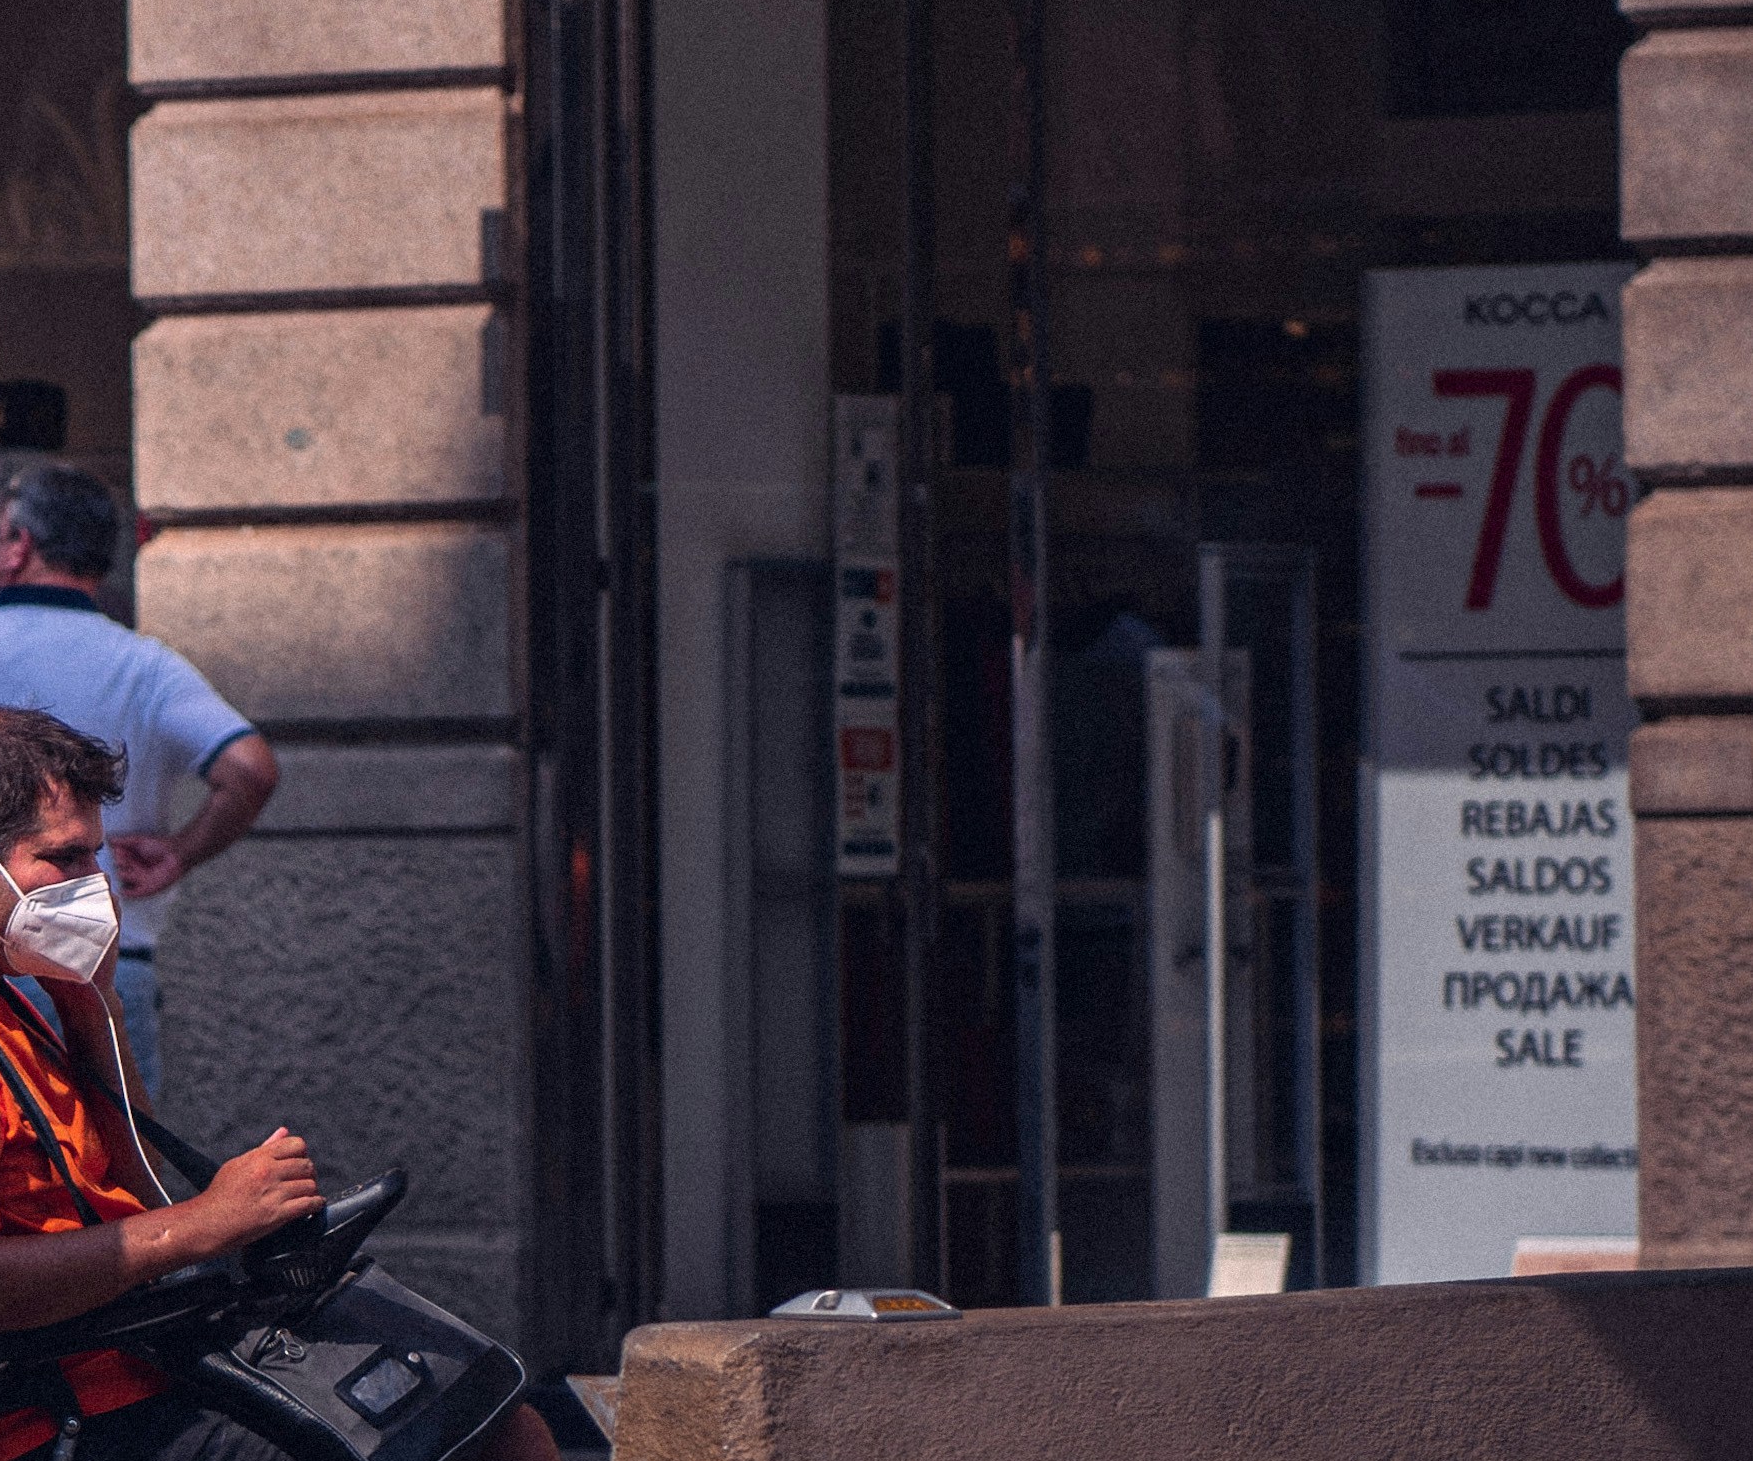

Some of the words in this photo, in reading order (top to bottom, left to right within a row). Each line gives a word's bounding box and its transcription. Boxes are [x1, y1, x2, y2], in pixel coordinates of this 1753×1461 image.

[1464, 292, 1608, 327] KOCCA
[1485, 685, 1591, 724] SALDI
[1467, 742, 1609, 780] SOLDES
[1461, 799, 1616, 839] REBAJAS
[1466, 856, 1612, 896] SALDOS
[1455, 914, 1620, 952] VERKAUF
[1442, 971, 1635, 1013] ПРОДАЖА
[1495, 1028, 1585, 1068] SALE
